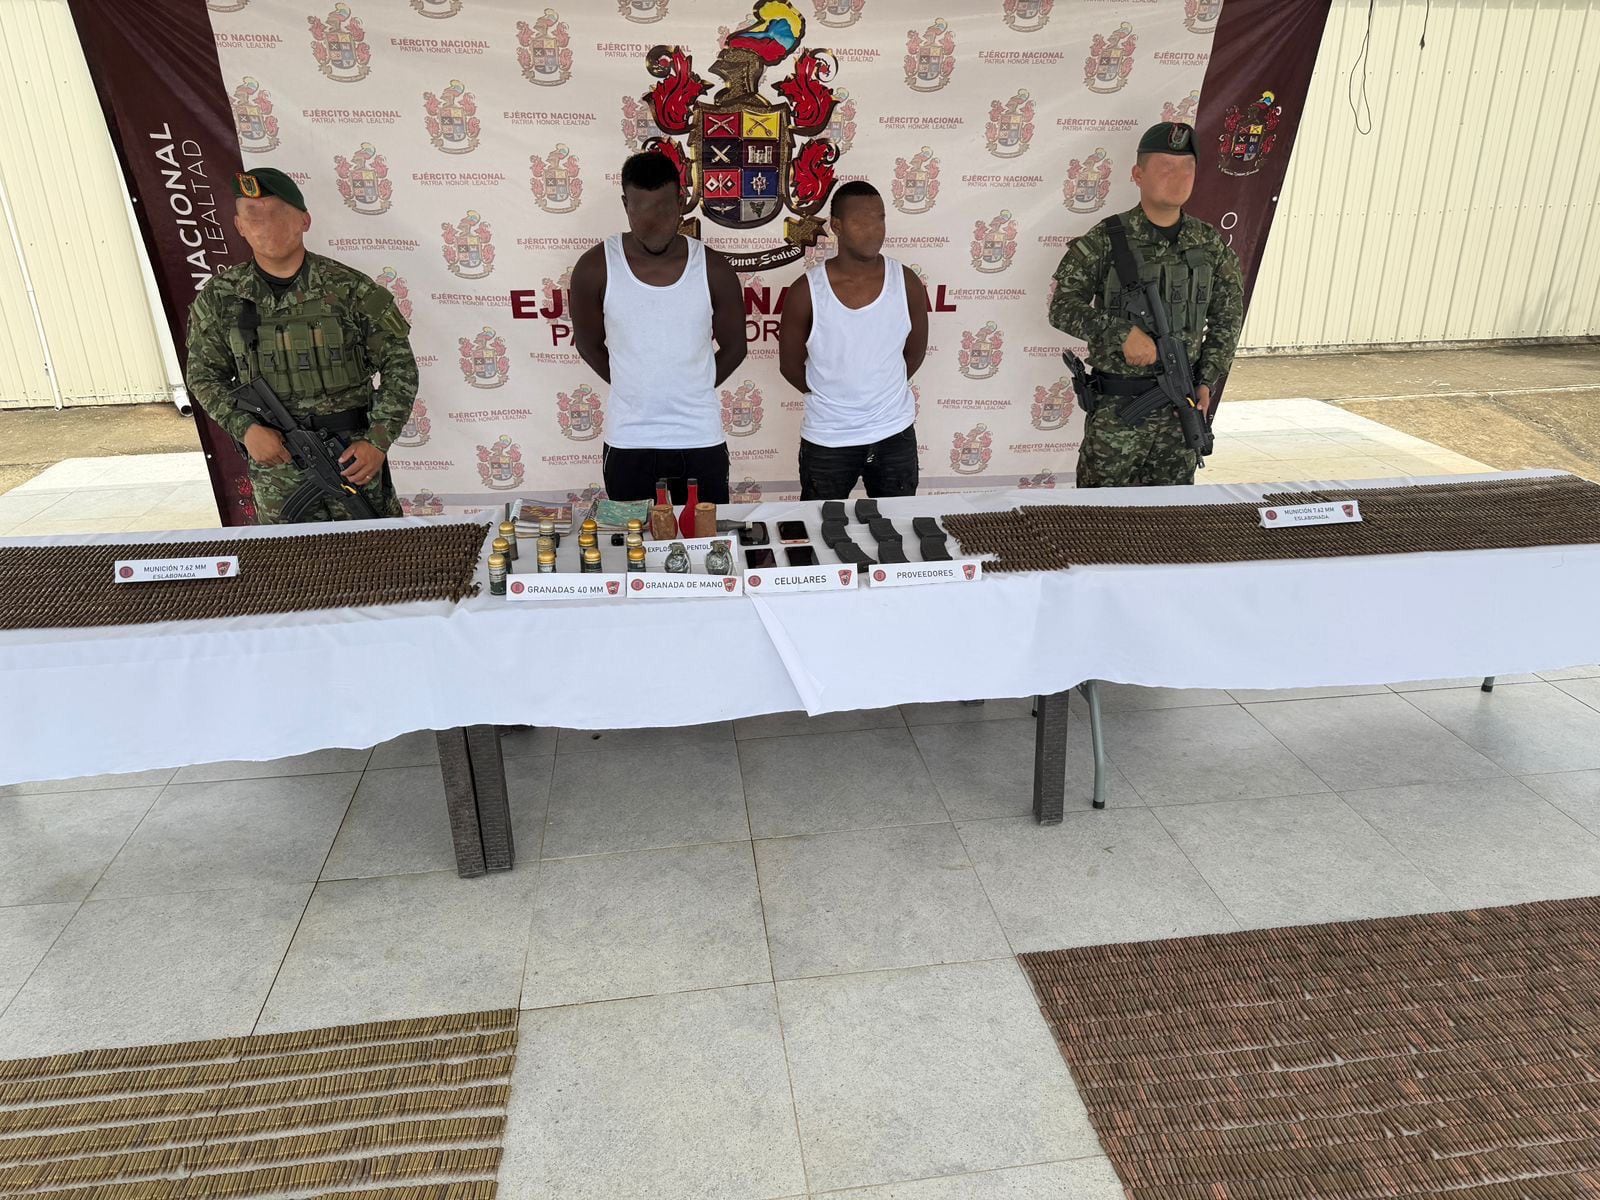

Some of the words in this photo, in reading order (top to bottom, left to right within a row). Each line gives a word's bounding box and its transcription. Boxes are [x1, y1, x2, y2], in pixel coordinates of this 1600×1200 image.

[231, 34, 283, 43] NACIONAL
[391, 38, 438, 46] EJÉRCITO
[441, 39, 490, 48] NACIONAL
[597, 41, 642, 51] EJÉRCITO
[979, 50, 1019, 58] EJÉRCITO
[303, 109, 350, 118] EJÉRCITO
[353, 109, 401, 118] NACIONAL
[504, 110, 548, 120] EJÉRCITO
[413, 172, 456, 181] EJÉRCITO
[182, 140, 228, 254] LEALTAD
[150, 123, 212, 291] NACIONAL
[328, 237, 373, 246] EJÉRCITO
[897, 570, 953, 578] PROVEEDORES
[775, 575, 826, 585] CELULARES
